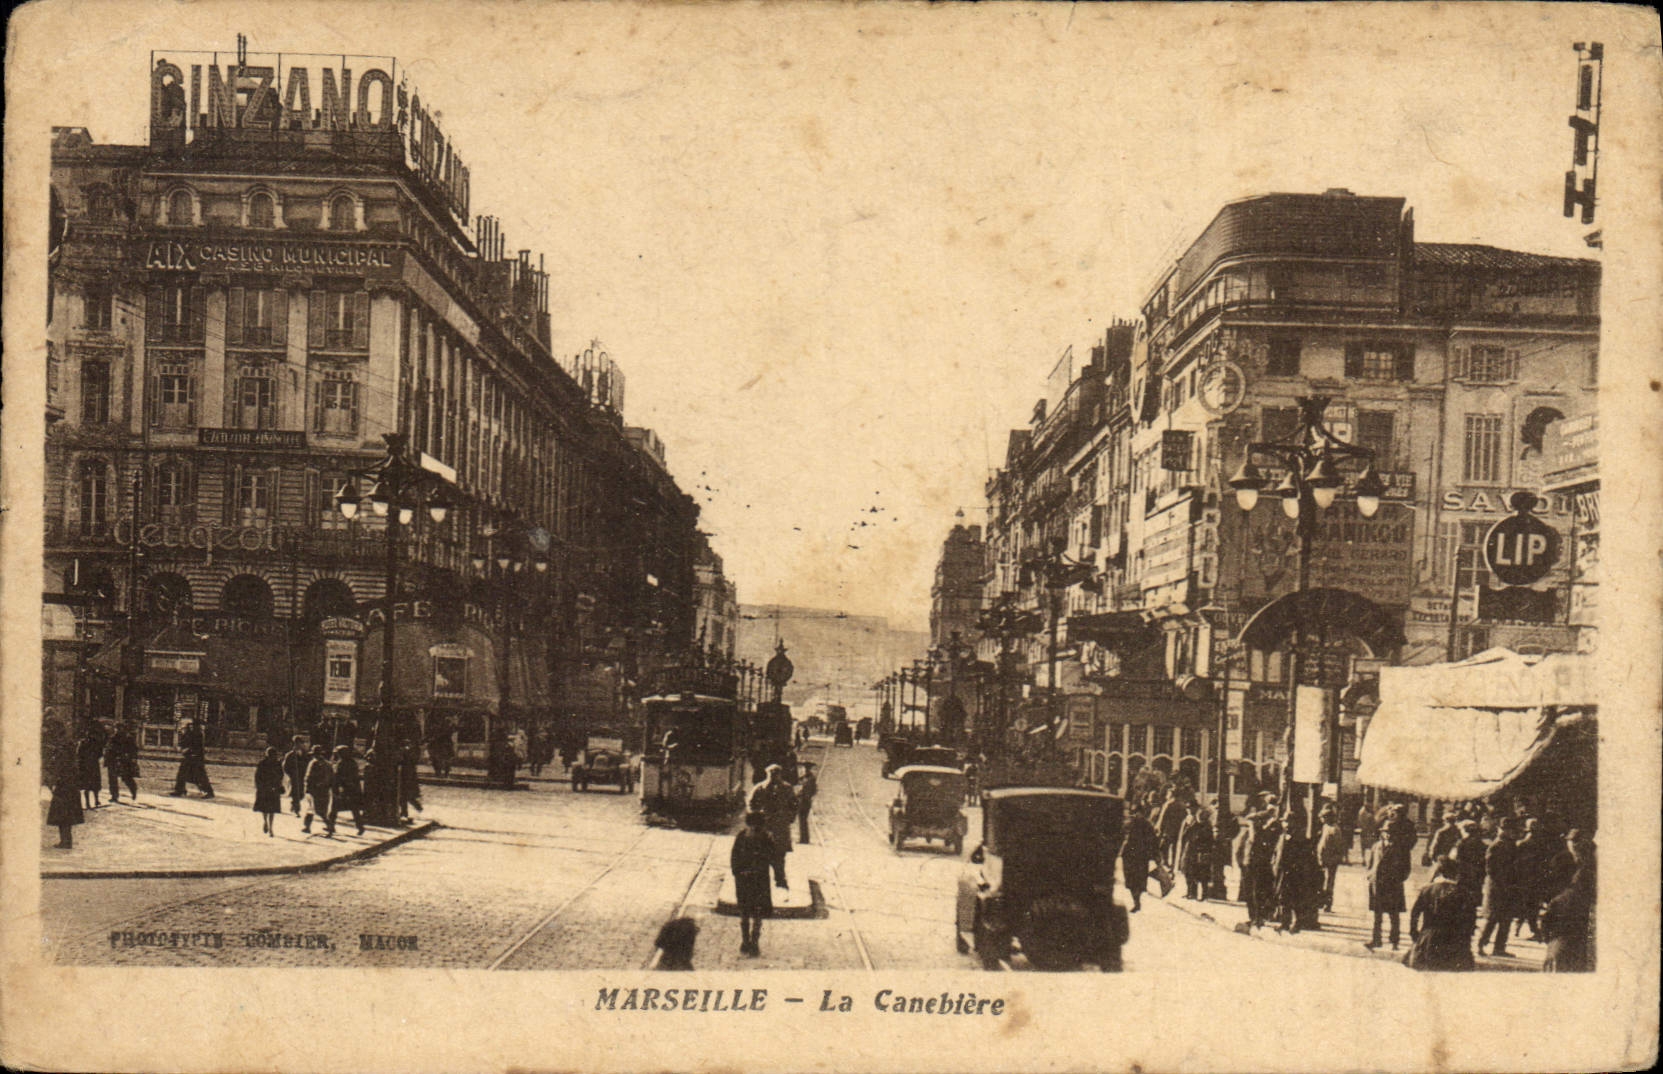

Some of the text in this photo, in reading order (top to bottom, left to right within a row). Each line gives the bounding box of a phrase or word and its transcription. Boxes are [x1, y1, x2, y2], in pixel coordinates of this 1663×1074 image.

[146, 241, 392, 271] AIX CASINO MUNICIPAL
[1495, 531, 1549, 567] LIP
